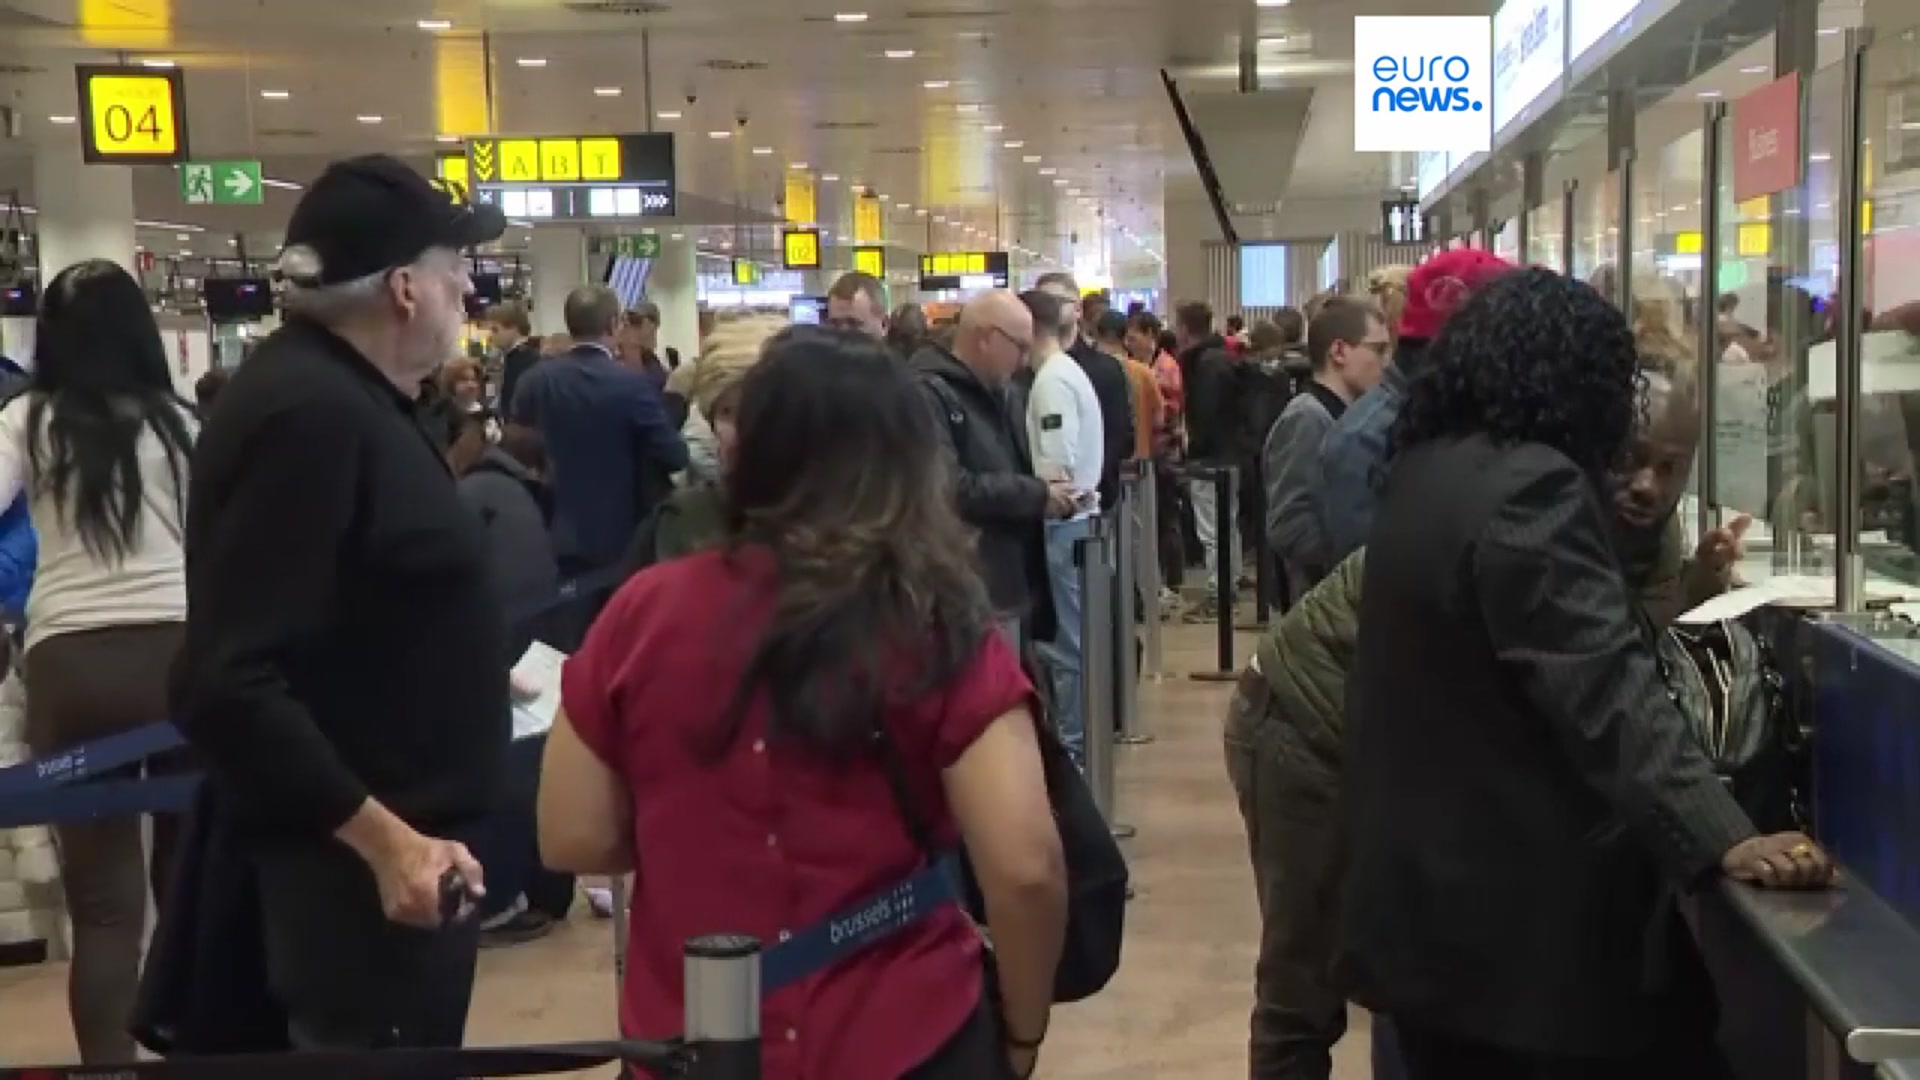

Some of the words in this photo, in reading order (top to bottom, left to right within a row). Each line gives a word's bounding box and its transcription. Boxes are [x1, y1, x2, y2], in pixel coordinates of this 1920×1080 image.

[104, 104, 163, 142] 04
[512, 155, 529, 176] A
[593, 152, 608, 175] T
[830, 898, 891, 945] brussels
